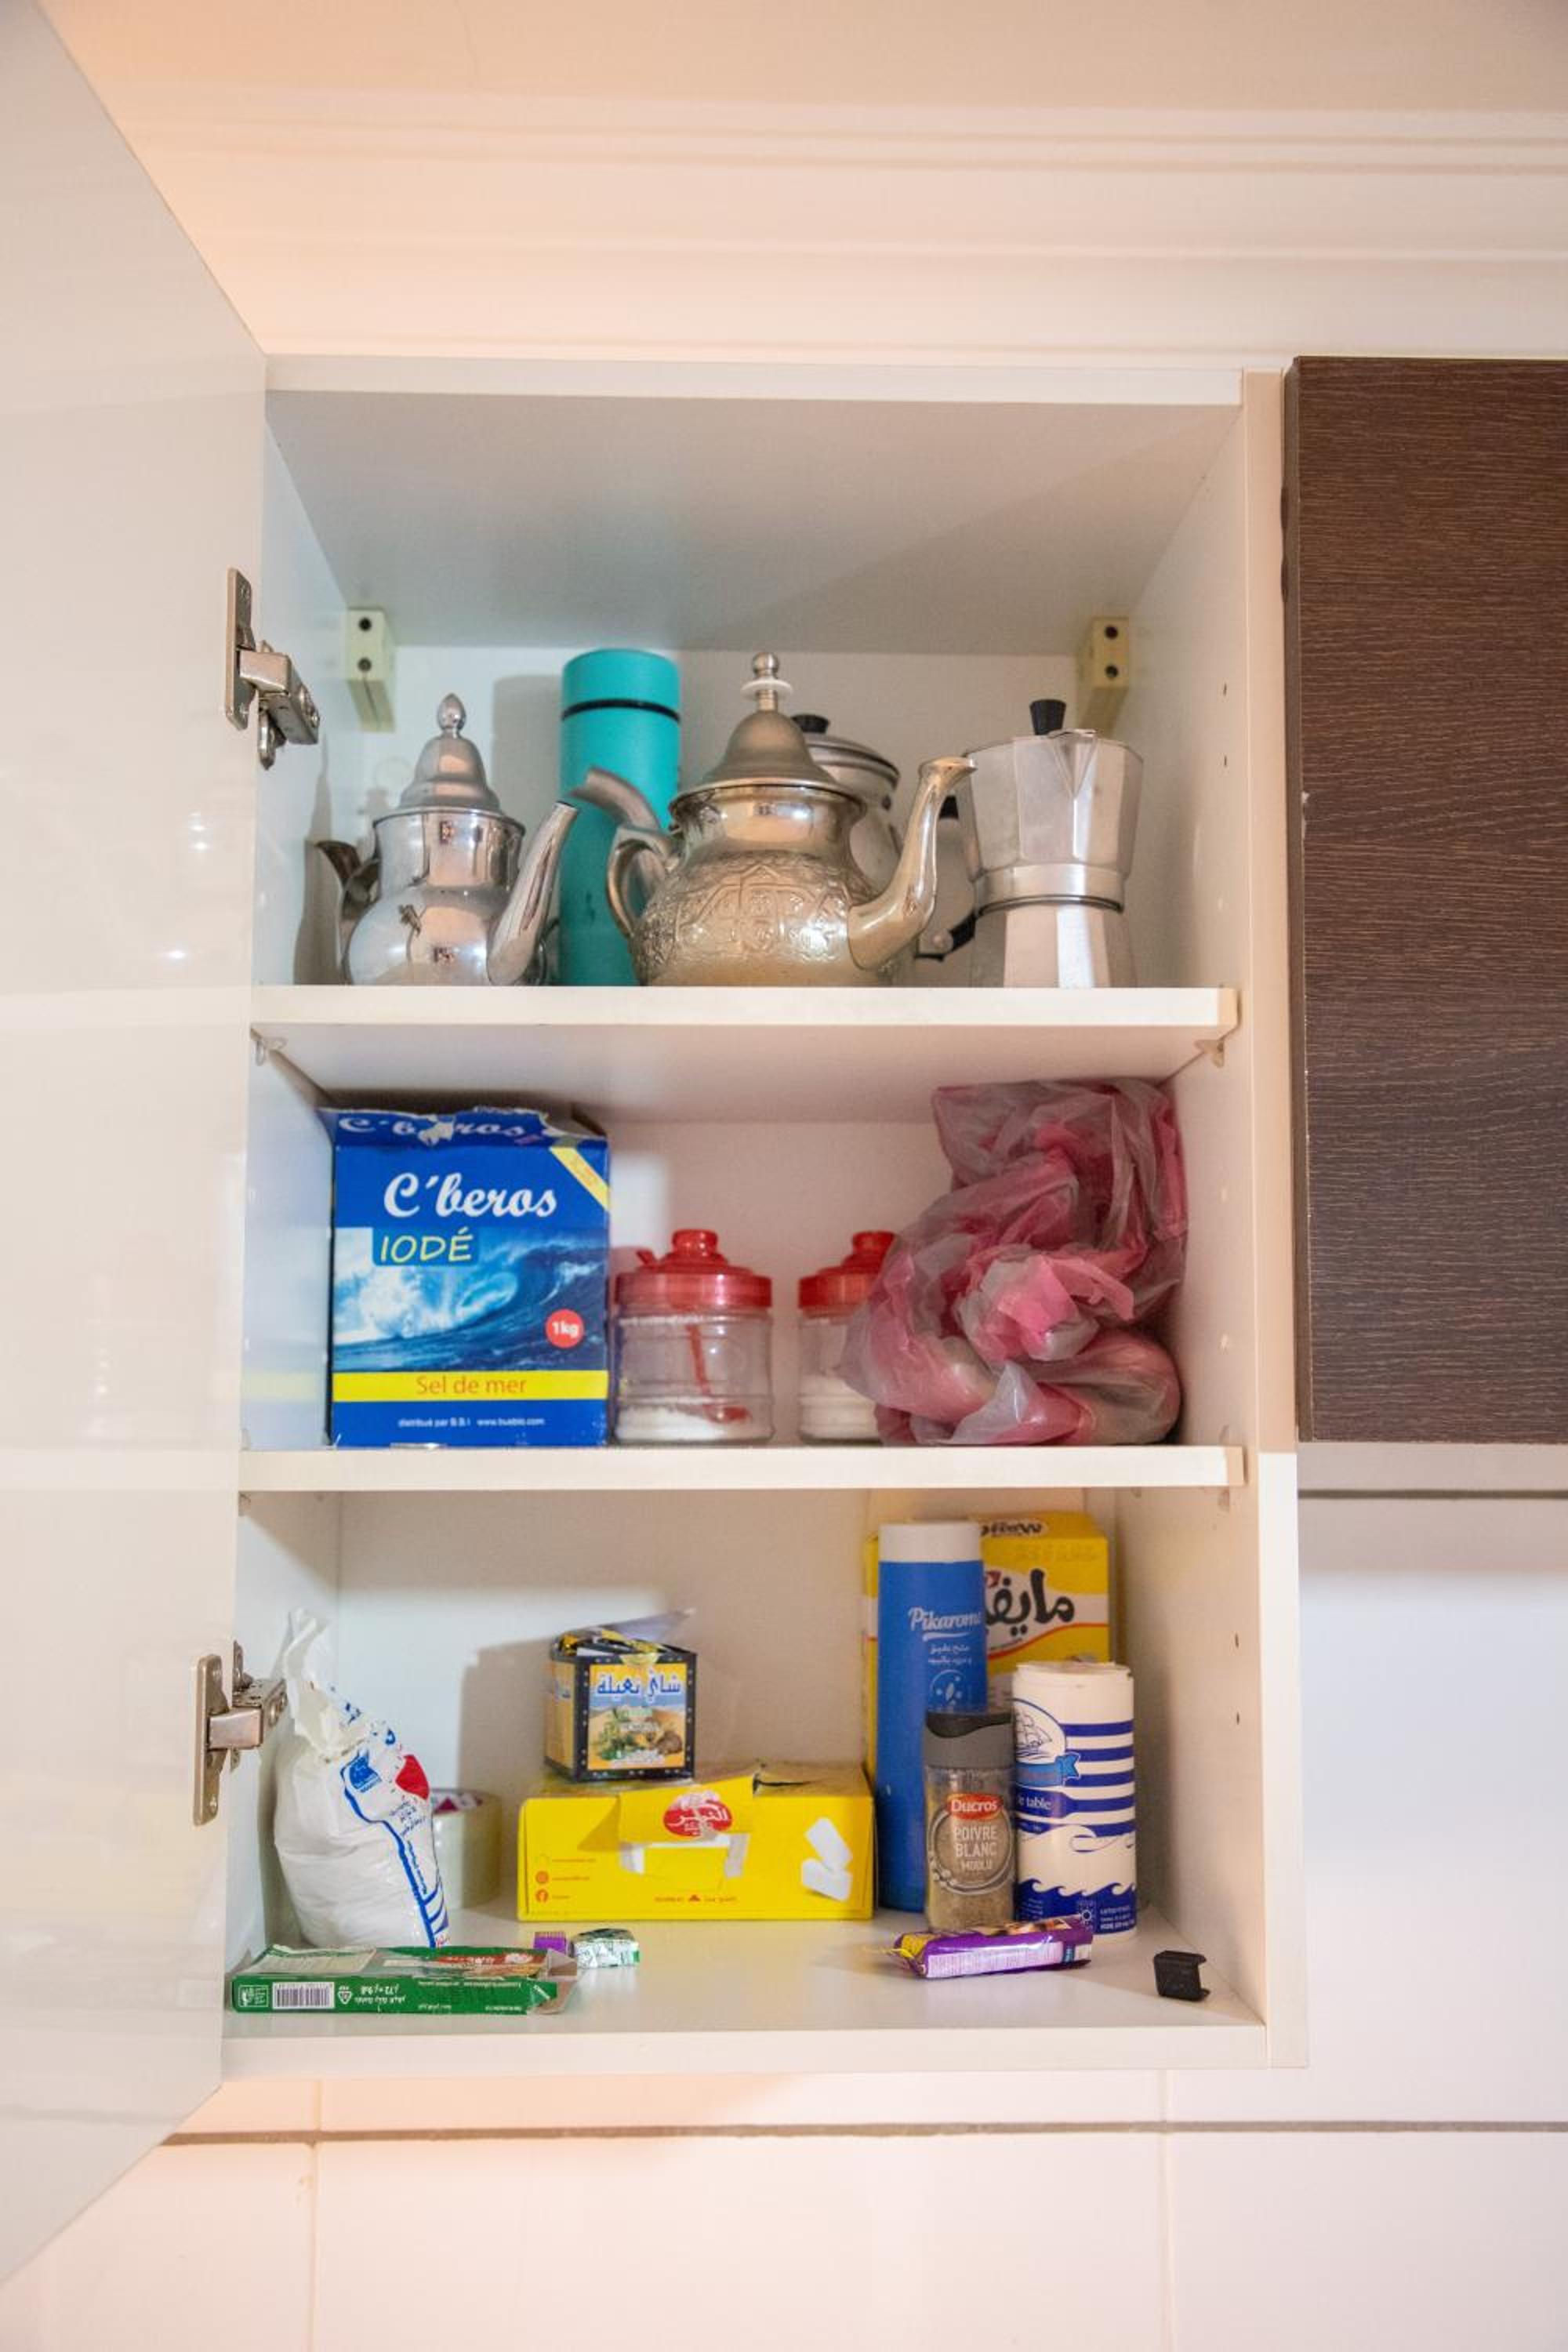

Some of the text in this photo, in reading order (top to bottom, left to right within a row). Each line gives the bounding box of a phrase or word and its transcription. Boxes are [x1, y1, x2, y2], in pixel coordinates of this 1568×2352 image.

[338, 1116, 526, 1137] C'bros
[383, 1172, 557, 1218] C'beros
[380, 1226, 474, 1263] IODÉ
[416, 1375, 527, 1395] Sel de mer
[908, 1606, 981, 1632] Pikarom
[950, 1798, 999, 1813] Ducros
[953, 1825, 998, 1842] POIVRE
[954, 1842, 997, 1858] BLANC
